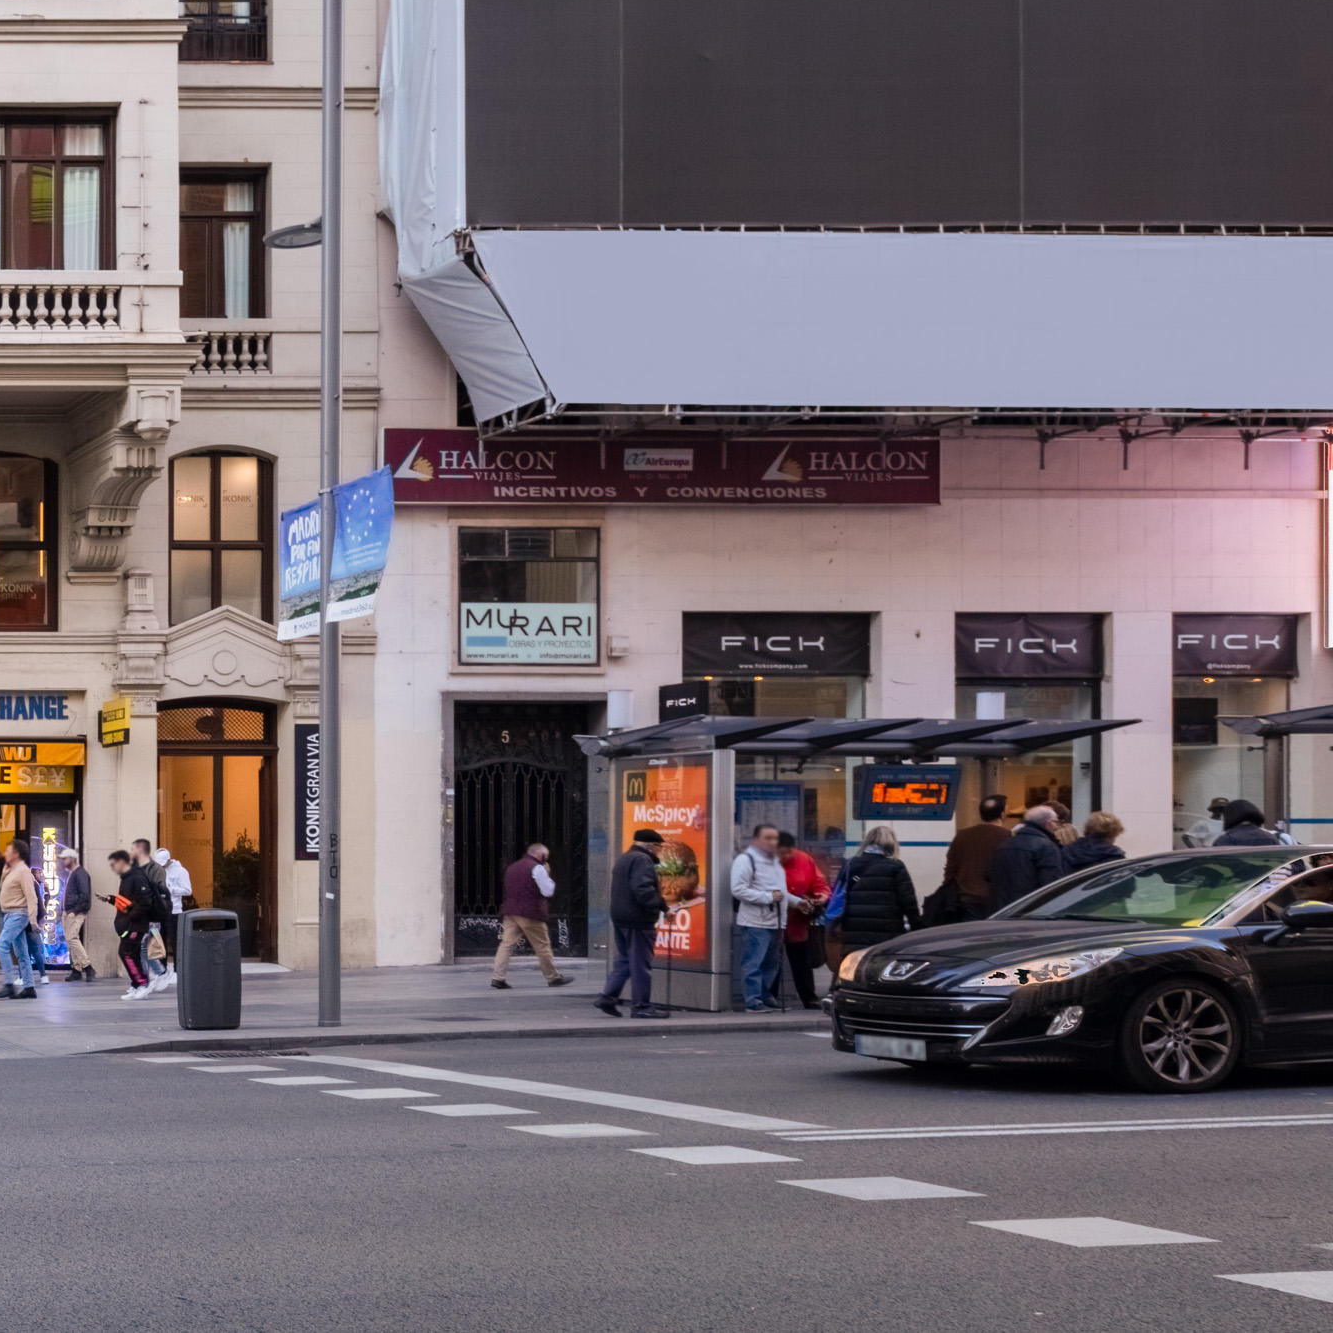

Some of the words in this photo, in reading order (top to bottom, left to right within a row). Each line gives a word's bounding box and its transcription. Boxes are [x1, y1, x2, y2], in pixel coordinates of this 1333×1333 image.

[438, 450, 557, 470] HALCON
[807, 451, 930, 471] HALCON
[474, 472, 522, 481] VIAJES
[844, 472, 893, 482] VIAJES
[493, 486, 617, 498] INCENTIVOS
[635, 486, 648, 498] Y
[666, 487, 828, 498] CONVENCIONES
[288, 509, 321, 546] MADRI
[285, 555, 321, 592] RESPIR
[466, 608, 591, 636] MURARI
[509, 640, 534, 648] OBRAS
[537, 640, 543, 648] Y
[544, 640, 591, 648] PROYECTOS
[721, 636, 825, 651] FICK
[975, 638, 1078, 654] FICK
[1177, 634, 1281, 650] FICK
[666, 697, 696, 708] FICK
[306, 733, 319, 757] VIA
[501, 730, 510, 743] 5
[306, 759, 320, 798] GRAN
[306, 798, 320, 853] IKONIK
[655, 931, 691, 950] ANTE
